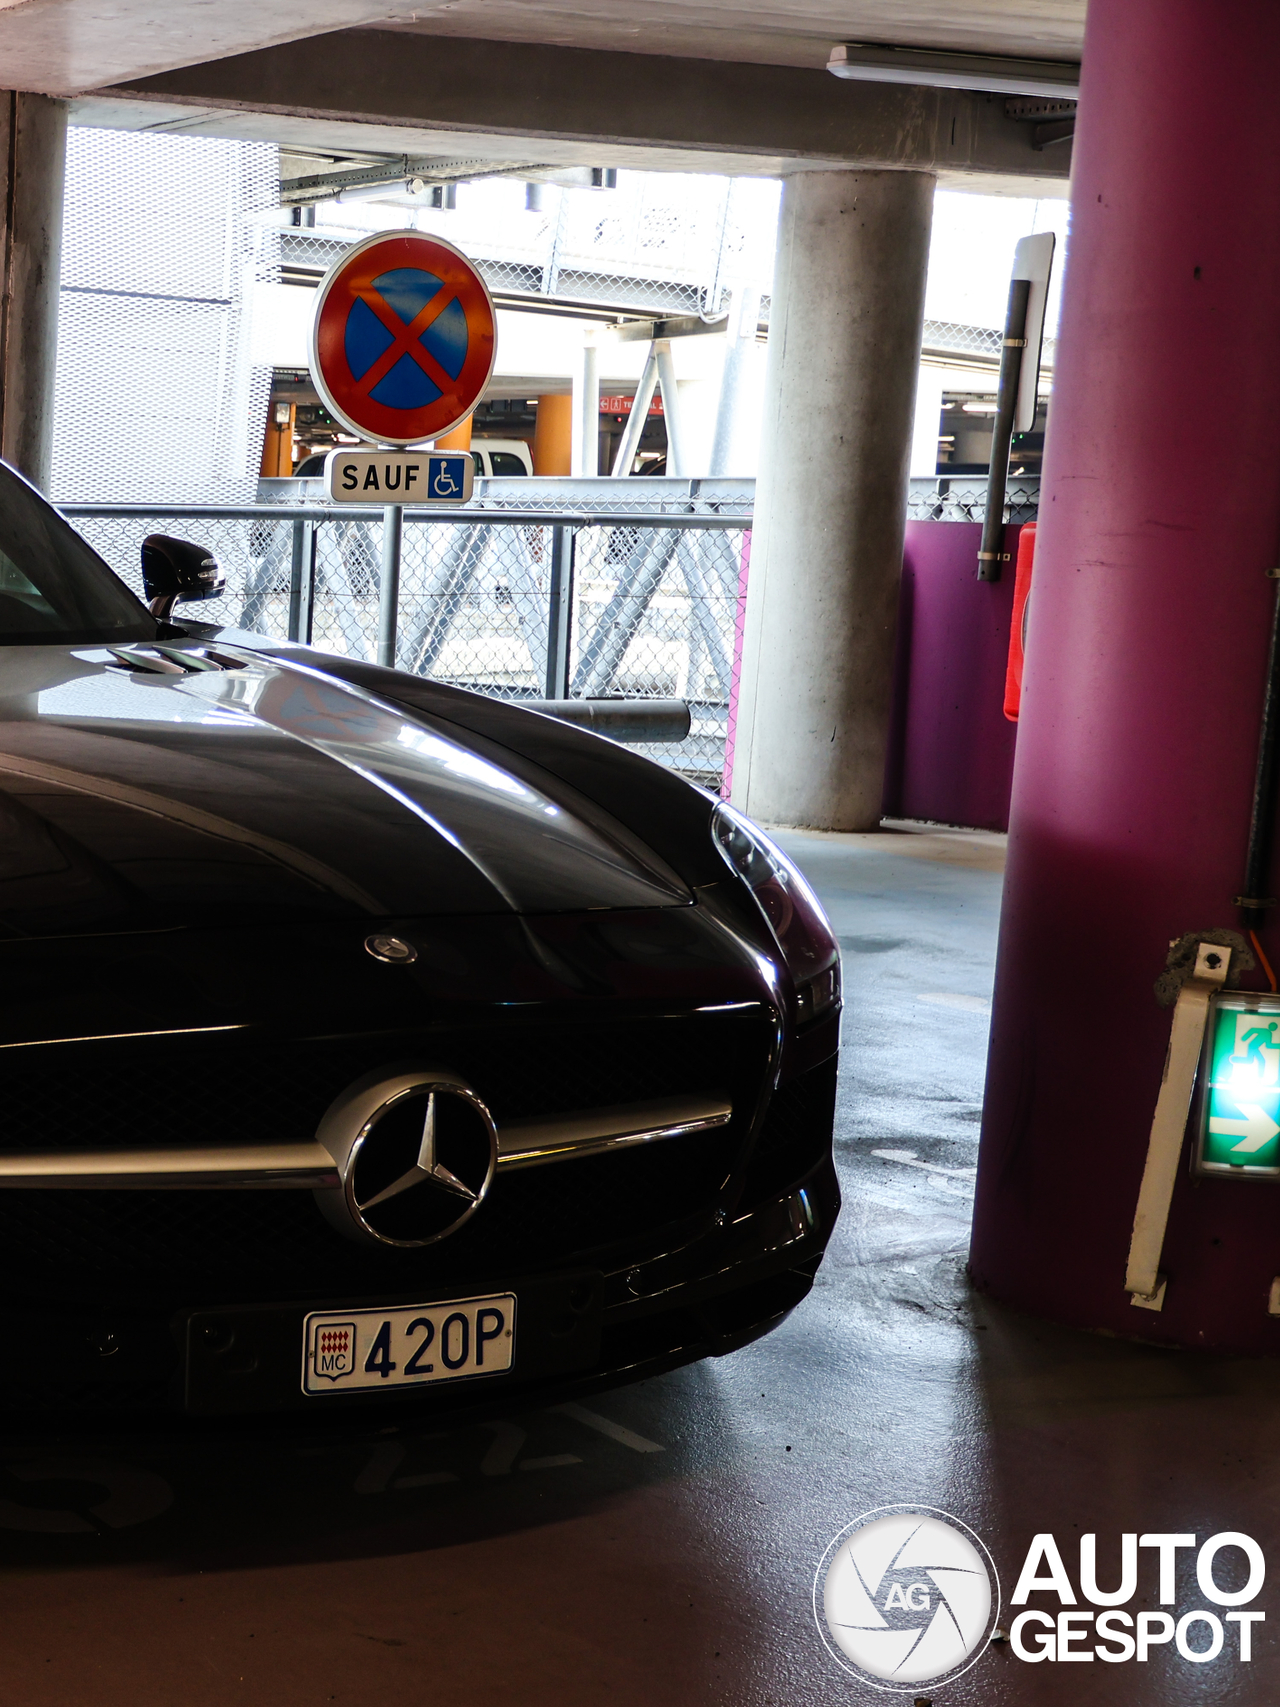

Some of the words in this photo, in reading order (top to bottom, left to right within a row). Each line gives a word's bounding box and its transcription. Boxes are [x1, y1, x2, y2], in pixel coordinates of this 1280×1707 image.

[342, 465, 419, 490] SAUF
[321, 1354, 346, 1371] MC
[364, 1308, 505, 1378] 420P
